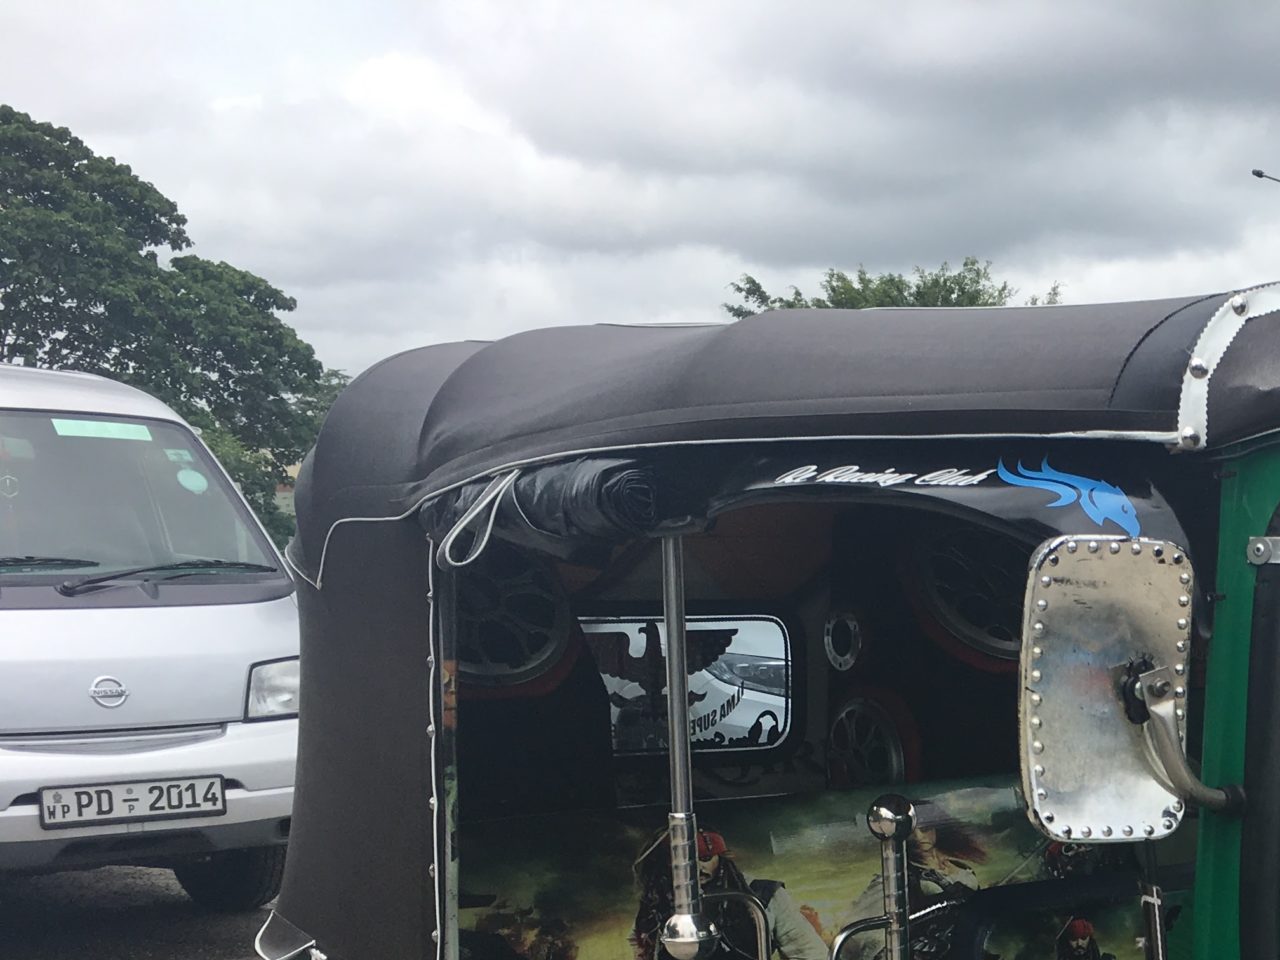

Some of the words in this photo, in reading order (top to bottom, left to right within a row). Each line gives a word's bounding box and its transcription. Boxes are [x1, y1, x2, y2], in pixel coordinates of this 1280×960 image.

[816, 465, 917, 487] Racing
[914, 468, 997, 486] Club
[93, 688, 127, 697] NISSAN
[47, 803, 71, 820] WP
